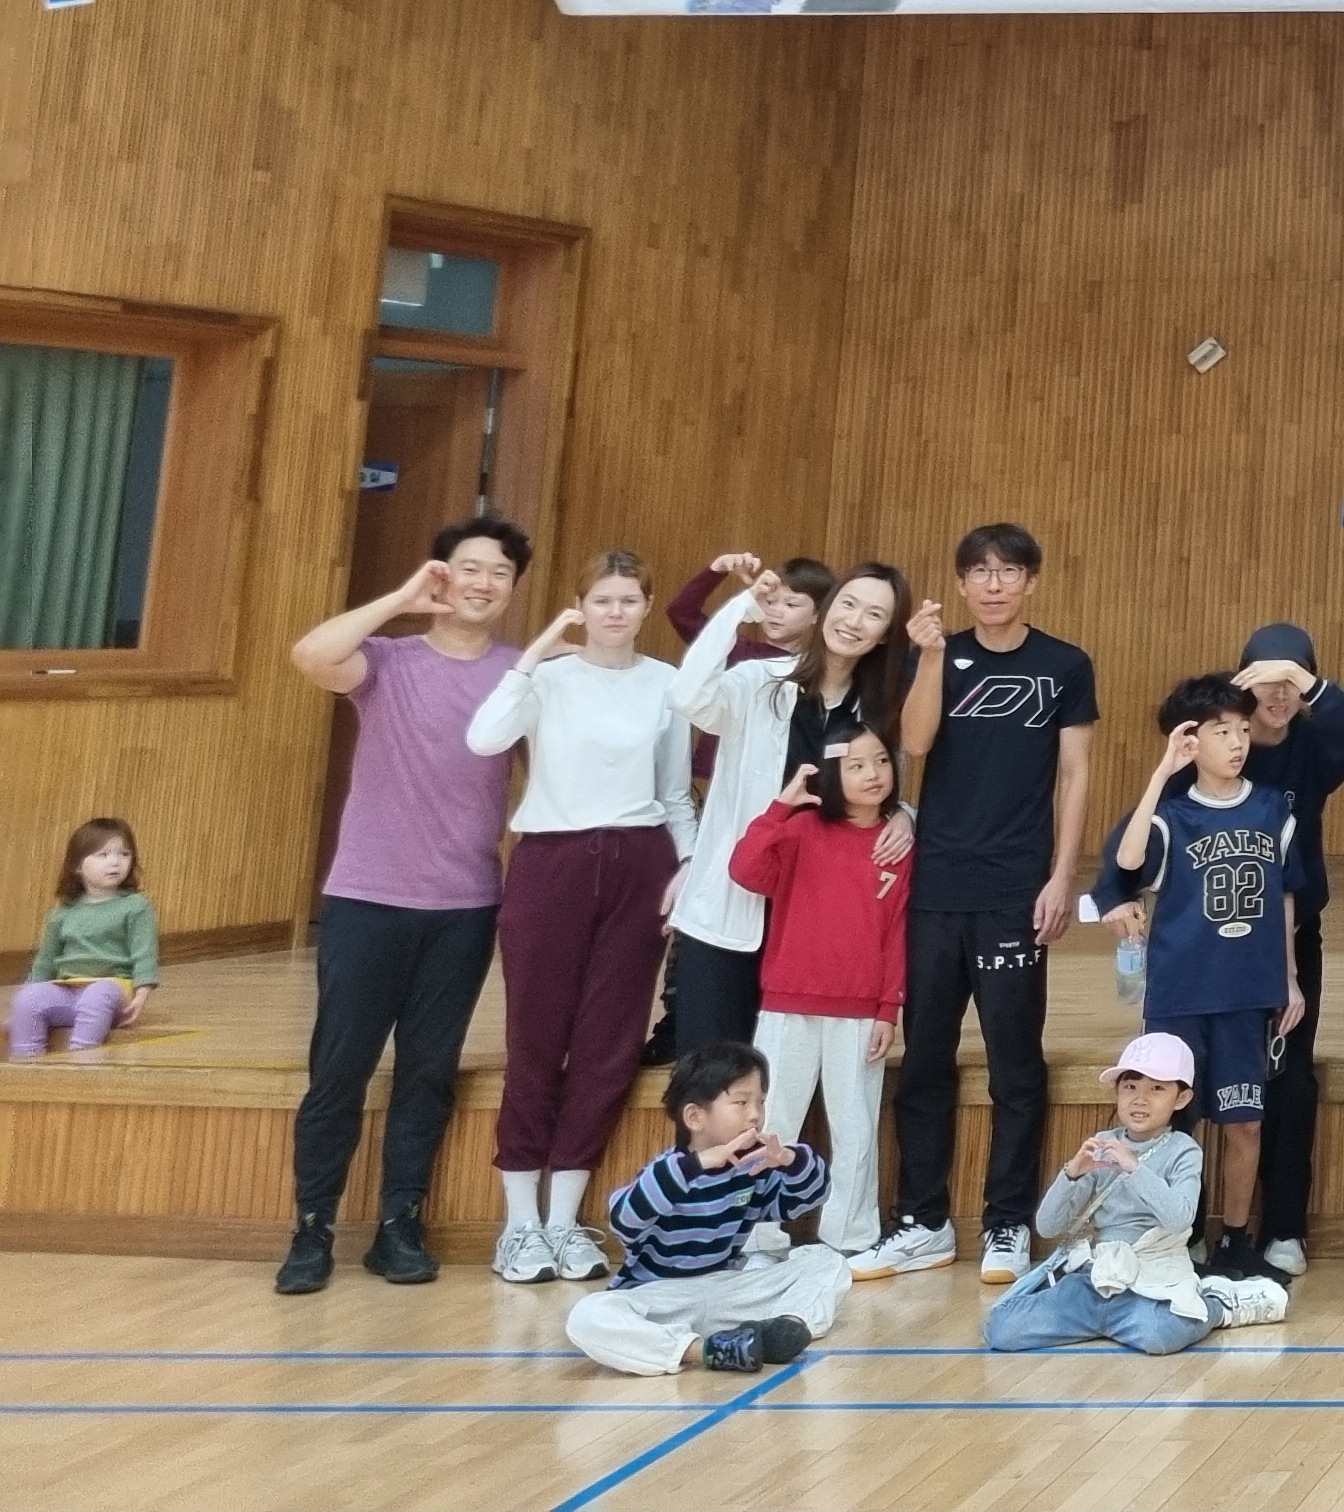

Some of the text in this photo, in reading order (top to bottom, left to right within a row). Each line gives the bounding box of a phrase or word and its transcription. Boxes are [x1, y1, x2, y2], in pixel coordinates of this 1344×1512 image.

[1185, 829, 1275, 870] YALE
[876, 870, 898, 900] 7
[1203, 861, 1265, 922] 82
[1216, 1083, 1264, 1112] YALE
